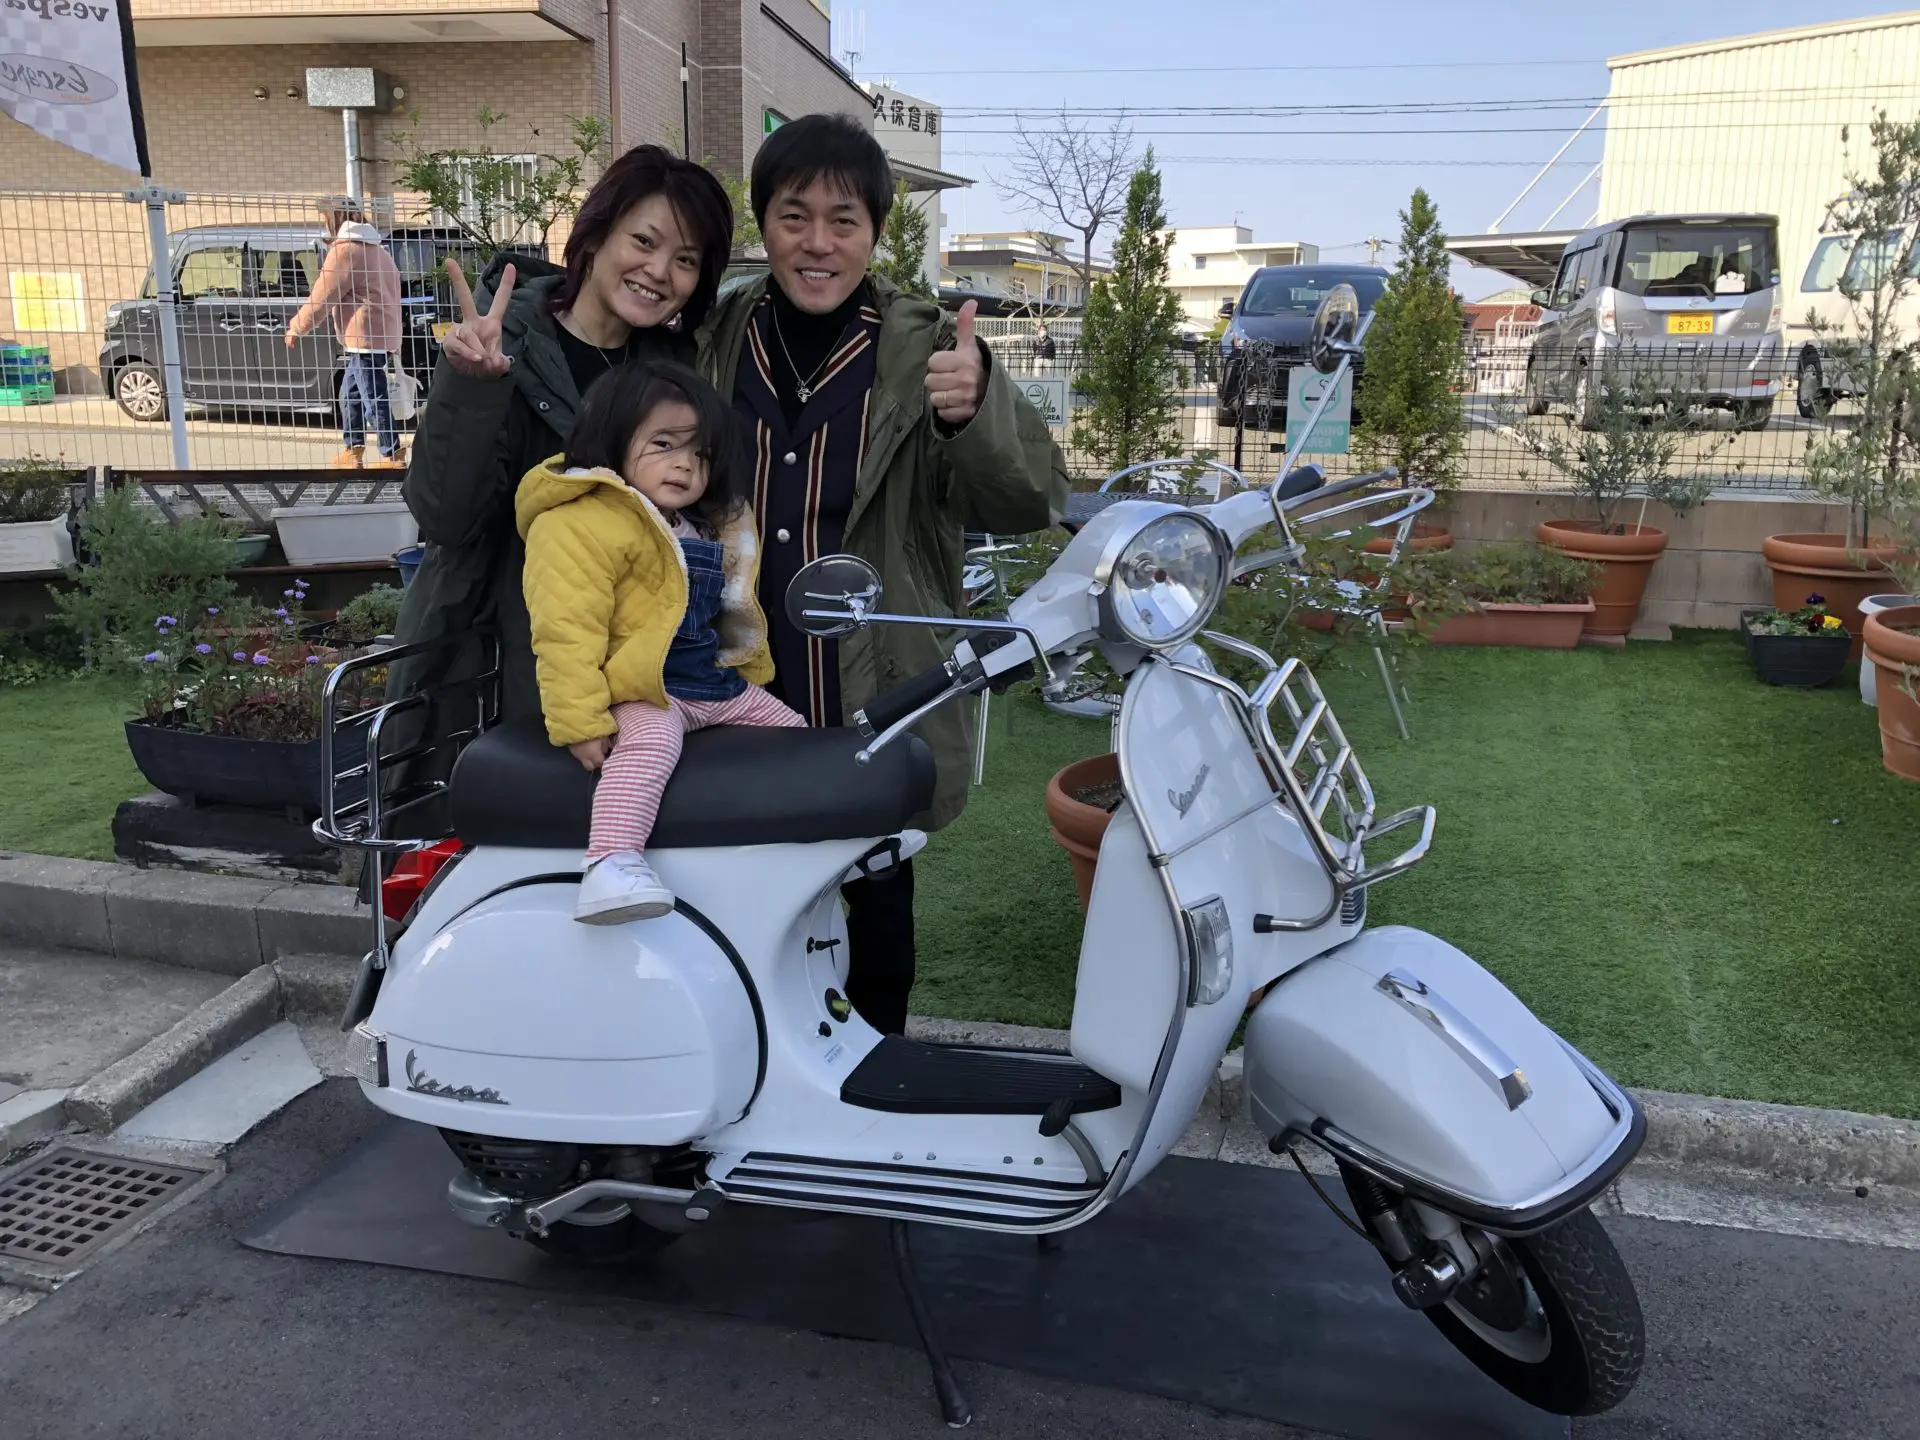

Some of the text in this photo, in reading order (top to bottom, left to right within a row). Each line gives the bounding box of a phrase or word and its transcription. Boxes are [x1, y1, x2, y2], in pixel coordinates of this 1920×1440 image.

[874, 92, 937, 138] 久保倉庫
[1677, 320, 1711, 332] 87-39
